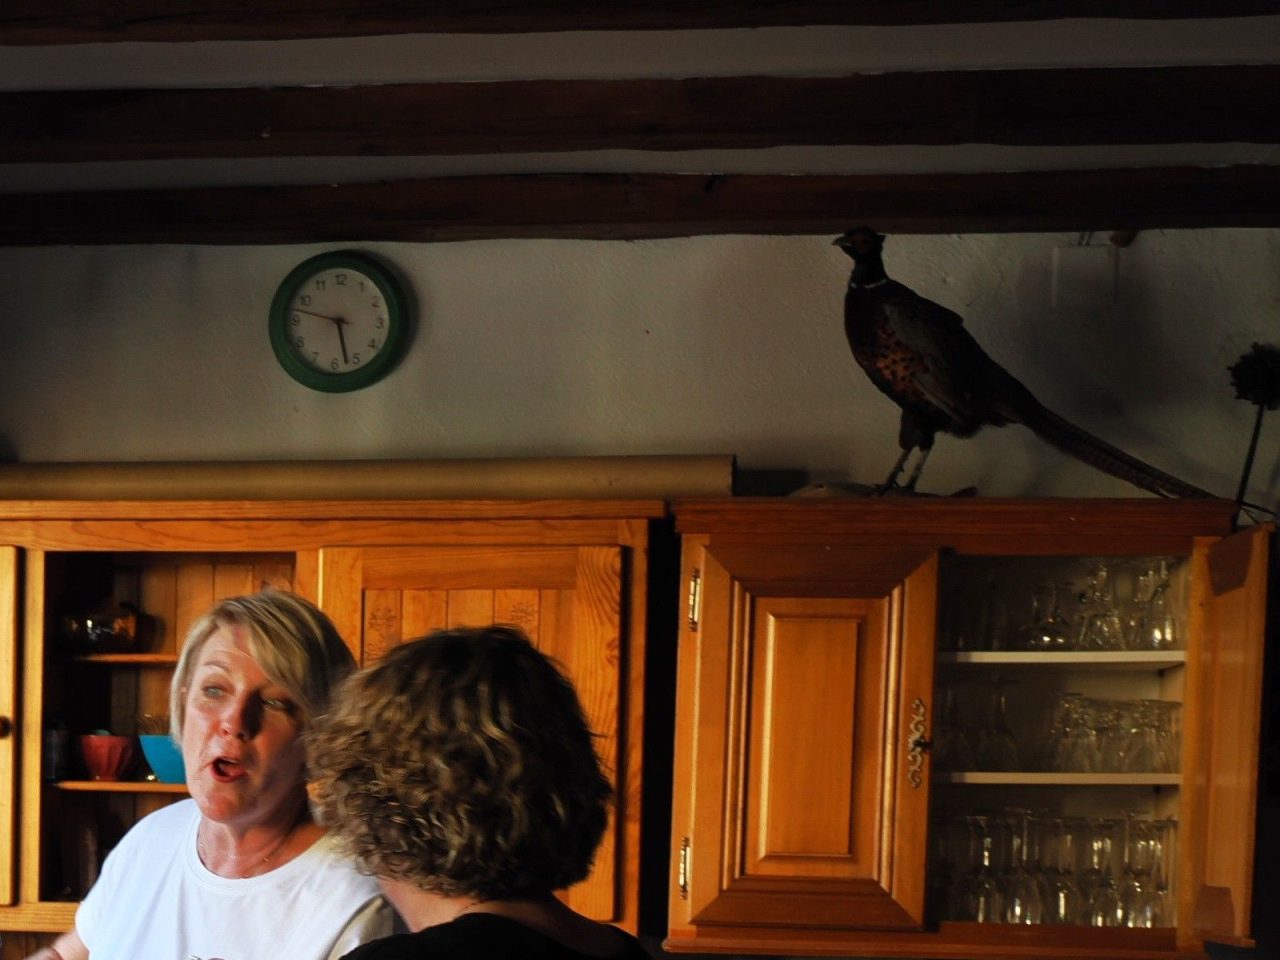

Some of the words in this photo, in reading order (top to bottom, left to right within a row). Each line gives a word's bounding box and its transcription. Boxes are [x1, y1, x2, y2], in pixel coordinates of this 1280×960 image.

[315, 280, 326, 291] 11
[335, 273, 348, 286] 12
[300, 295, 312, 307] 10
[371, 295, 380, 308] 2
[376, 317, 385, 329] 3
[368, 338, 377, 349] 4
[311, 351, 320, 363] 7
[352, 353, 361, 365] 5
[330, 358, 340, 370] 6
